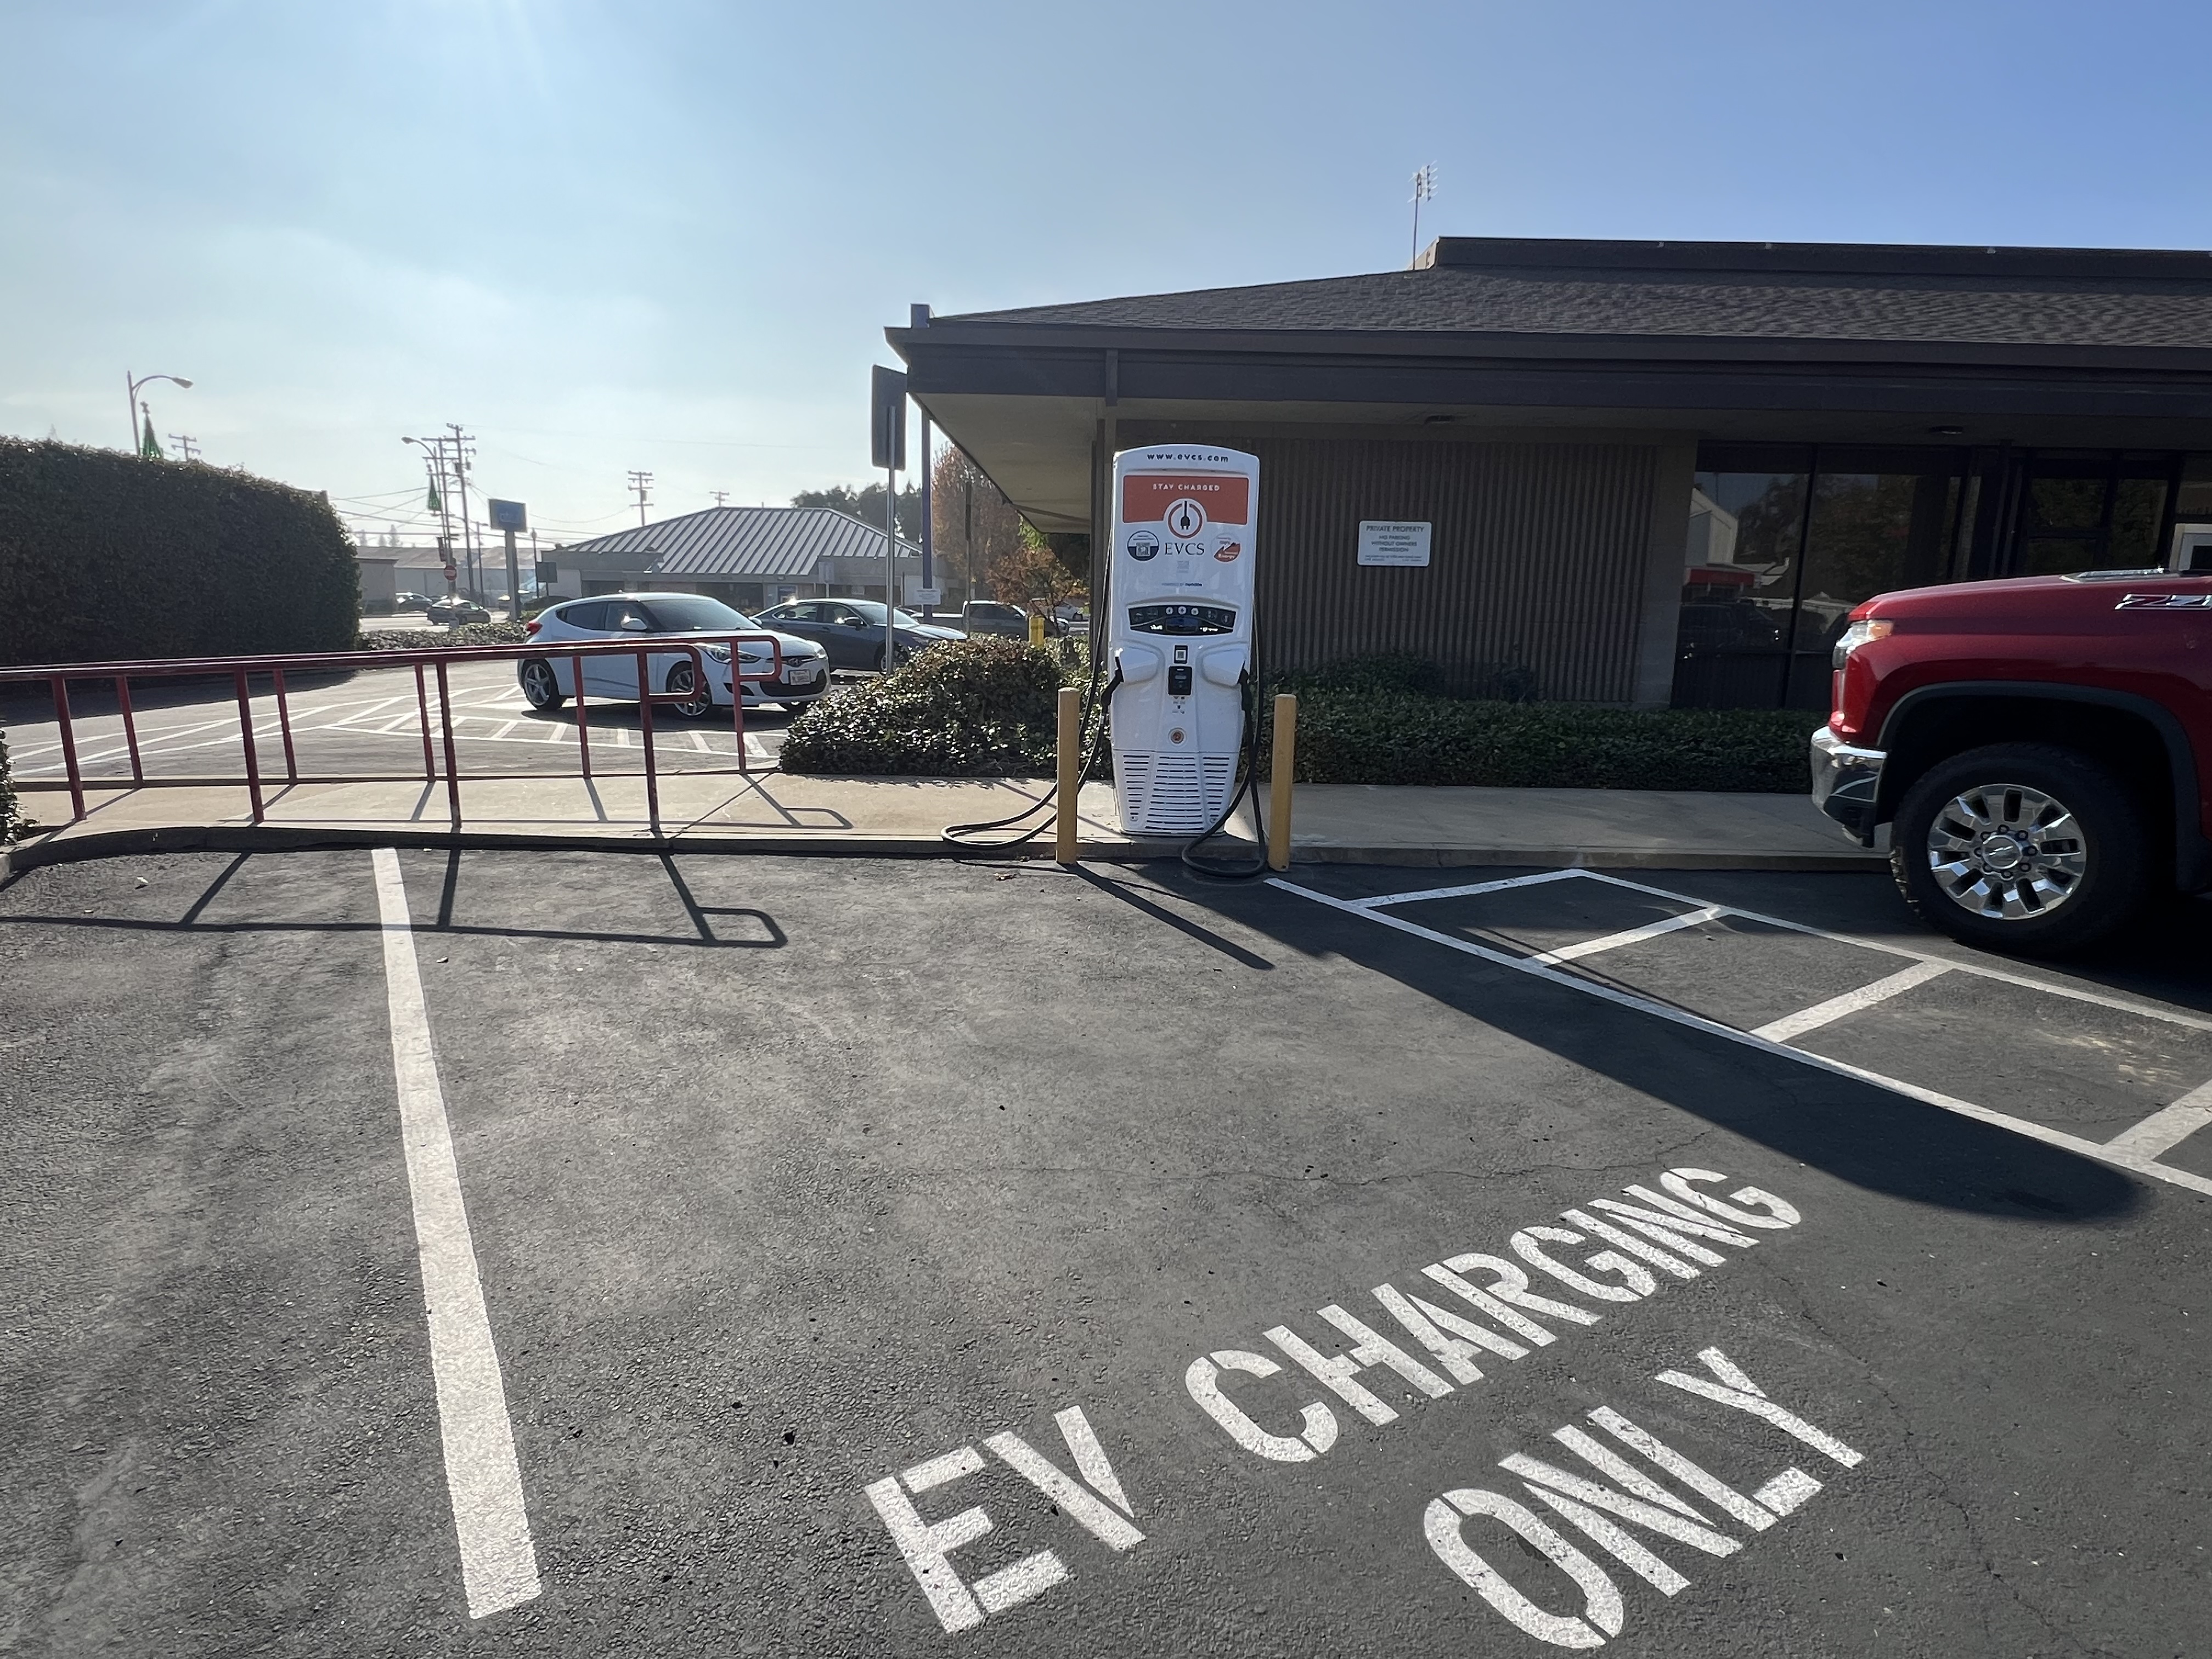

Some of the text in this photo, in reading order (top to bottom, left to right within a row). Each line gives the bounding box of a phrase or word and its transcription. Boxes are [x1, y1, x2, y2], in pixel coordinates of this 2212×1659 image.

[1147, 453, 1229, 463] www.evcs.com
[1164, 542, 1205, 556] EVCS
[864, 1167, 1802, 1634] EV CHARGING
[1423, 1346, 1864, 1649] ONLY
